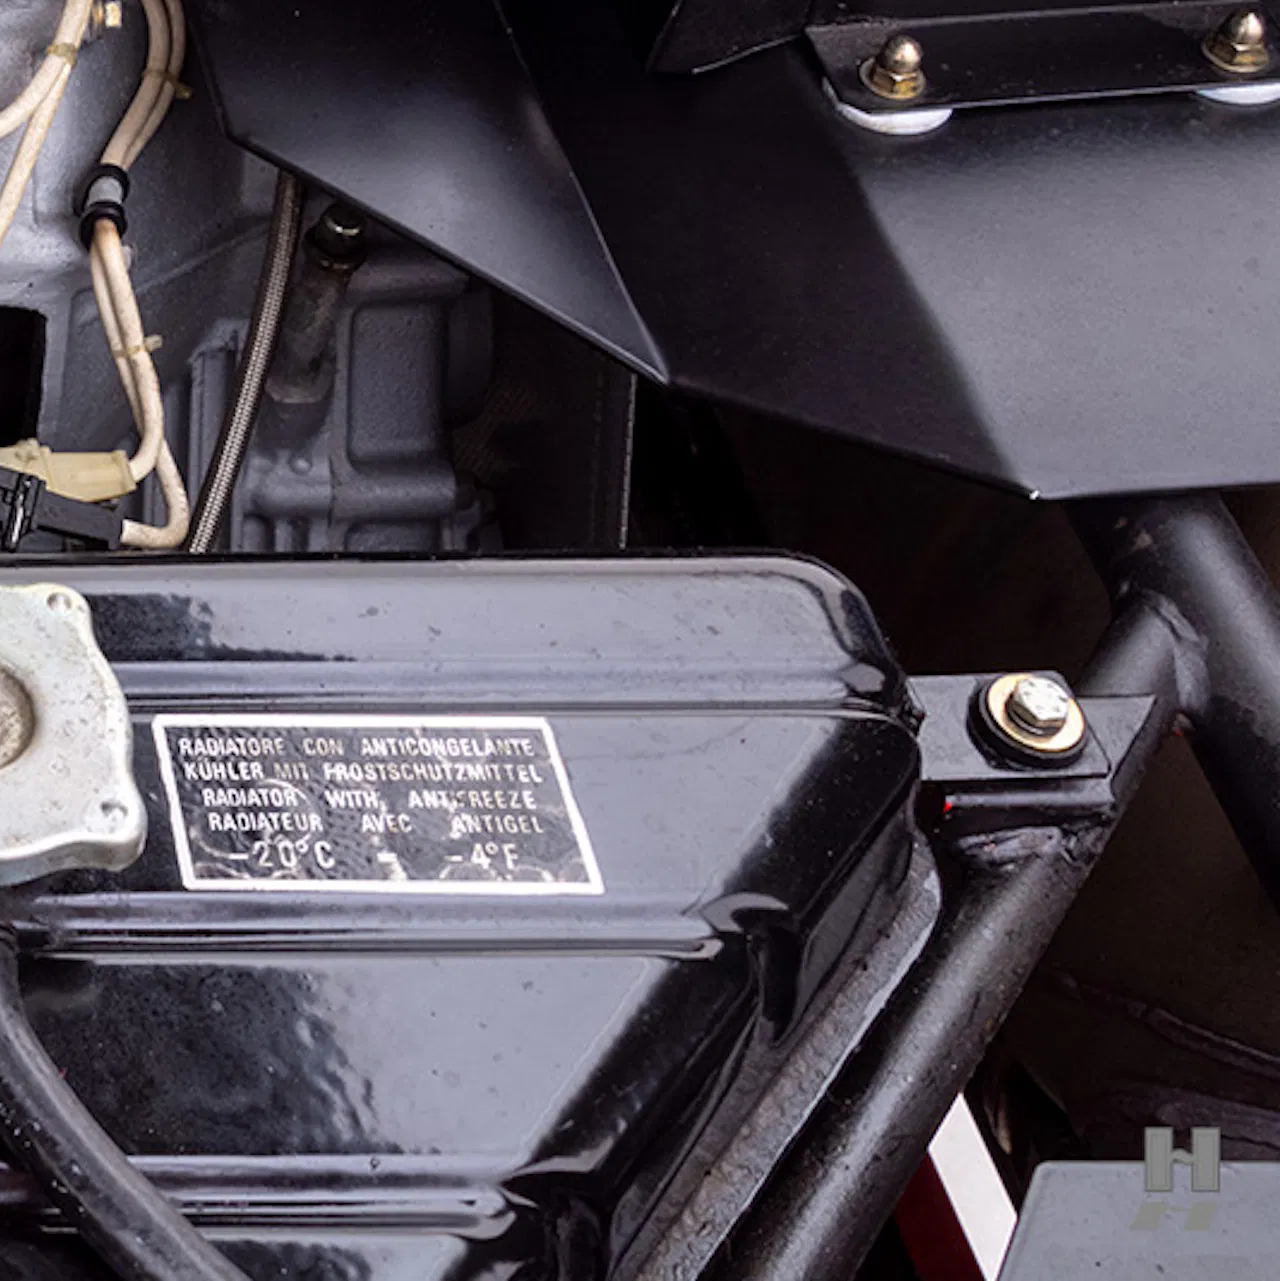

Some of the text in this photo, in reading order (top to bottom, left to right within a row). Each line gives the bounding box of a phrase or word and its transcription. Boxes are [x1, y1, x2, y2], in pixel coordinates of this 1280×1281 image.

[178, 737, 536, 758] RADIATORE CON ANTICONGELANTE
[183, 759, 544, 783] KÜHLER MIT FROSTSCHUTZMITTEL
[201, 788, 300, 808] RADIATOR
[324, 790, 379, 809] WITH
[207, 814, 545, 834] RADIATEUR AVEC ANTIGEL
